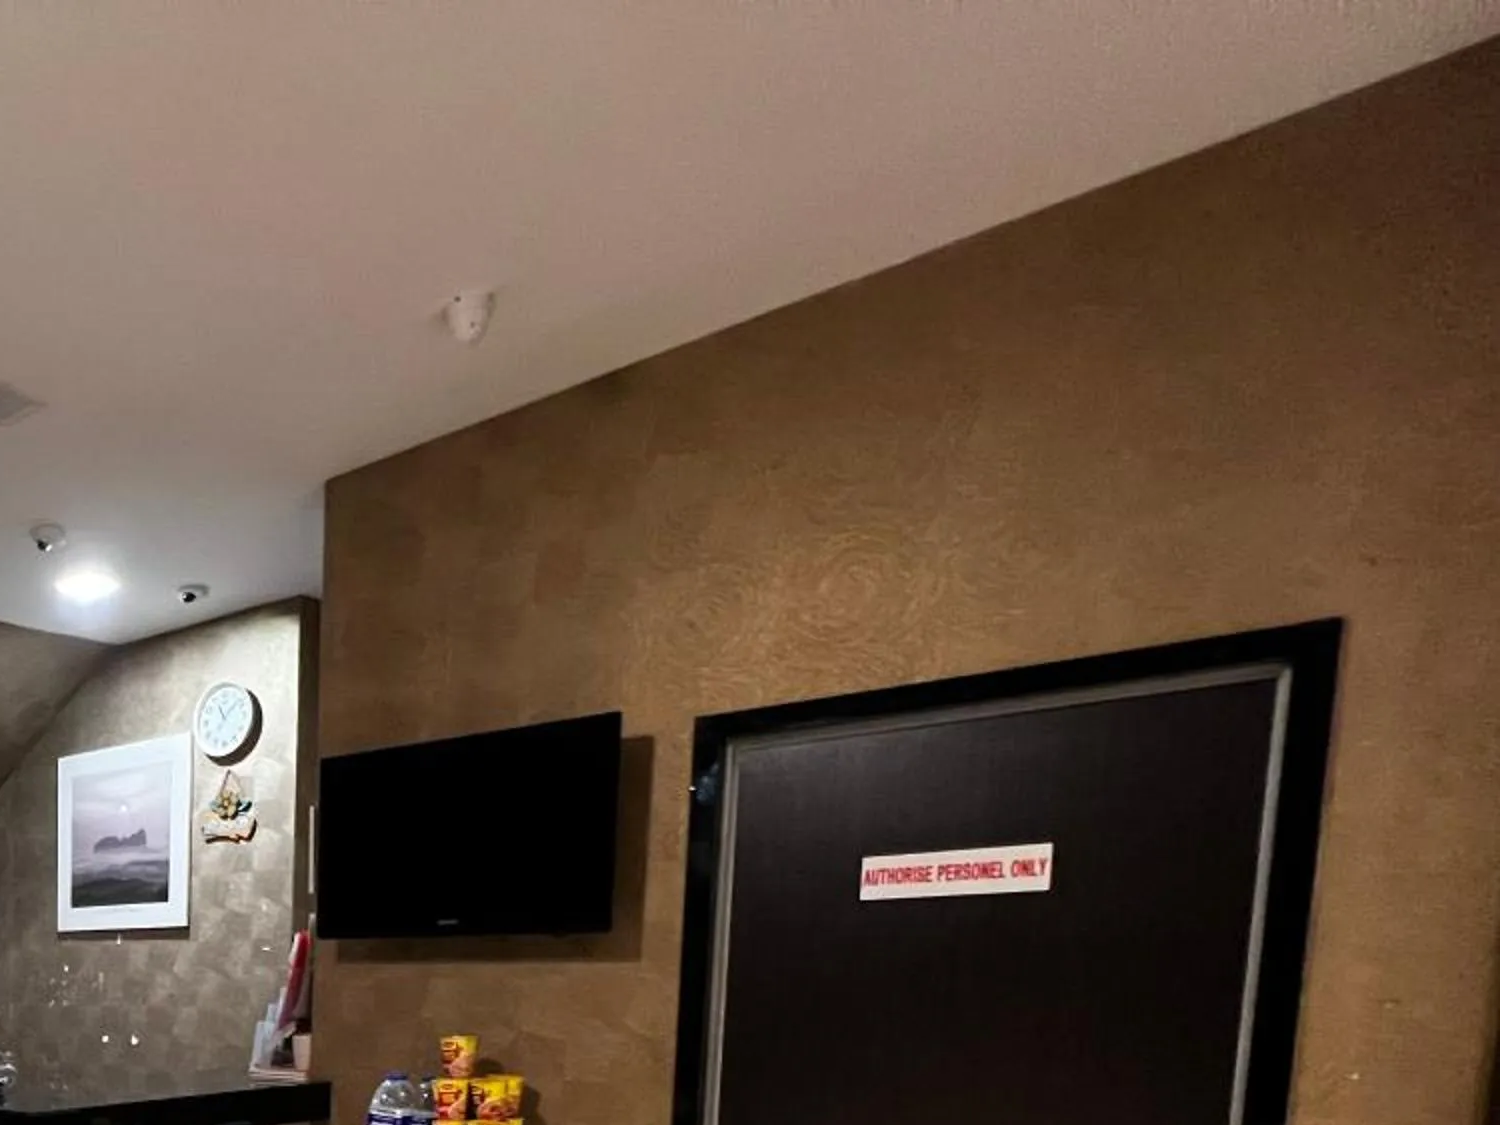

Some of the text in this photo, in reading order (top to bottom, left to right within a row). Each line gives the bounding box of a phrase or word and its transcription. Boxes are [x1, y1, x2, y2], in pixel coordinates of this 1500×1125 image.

[863, 857, 1048, 886] AUTHORISE PERSONEL ONLY
